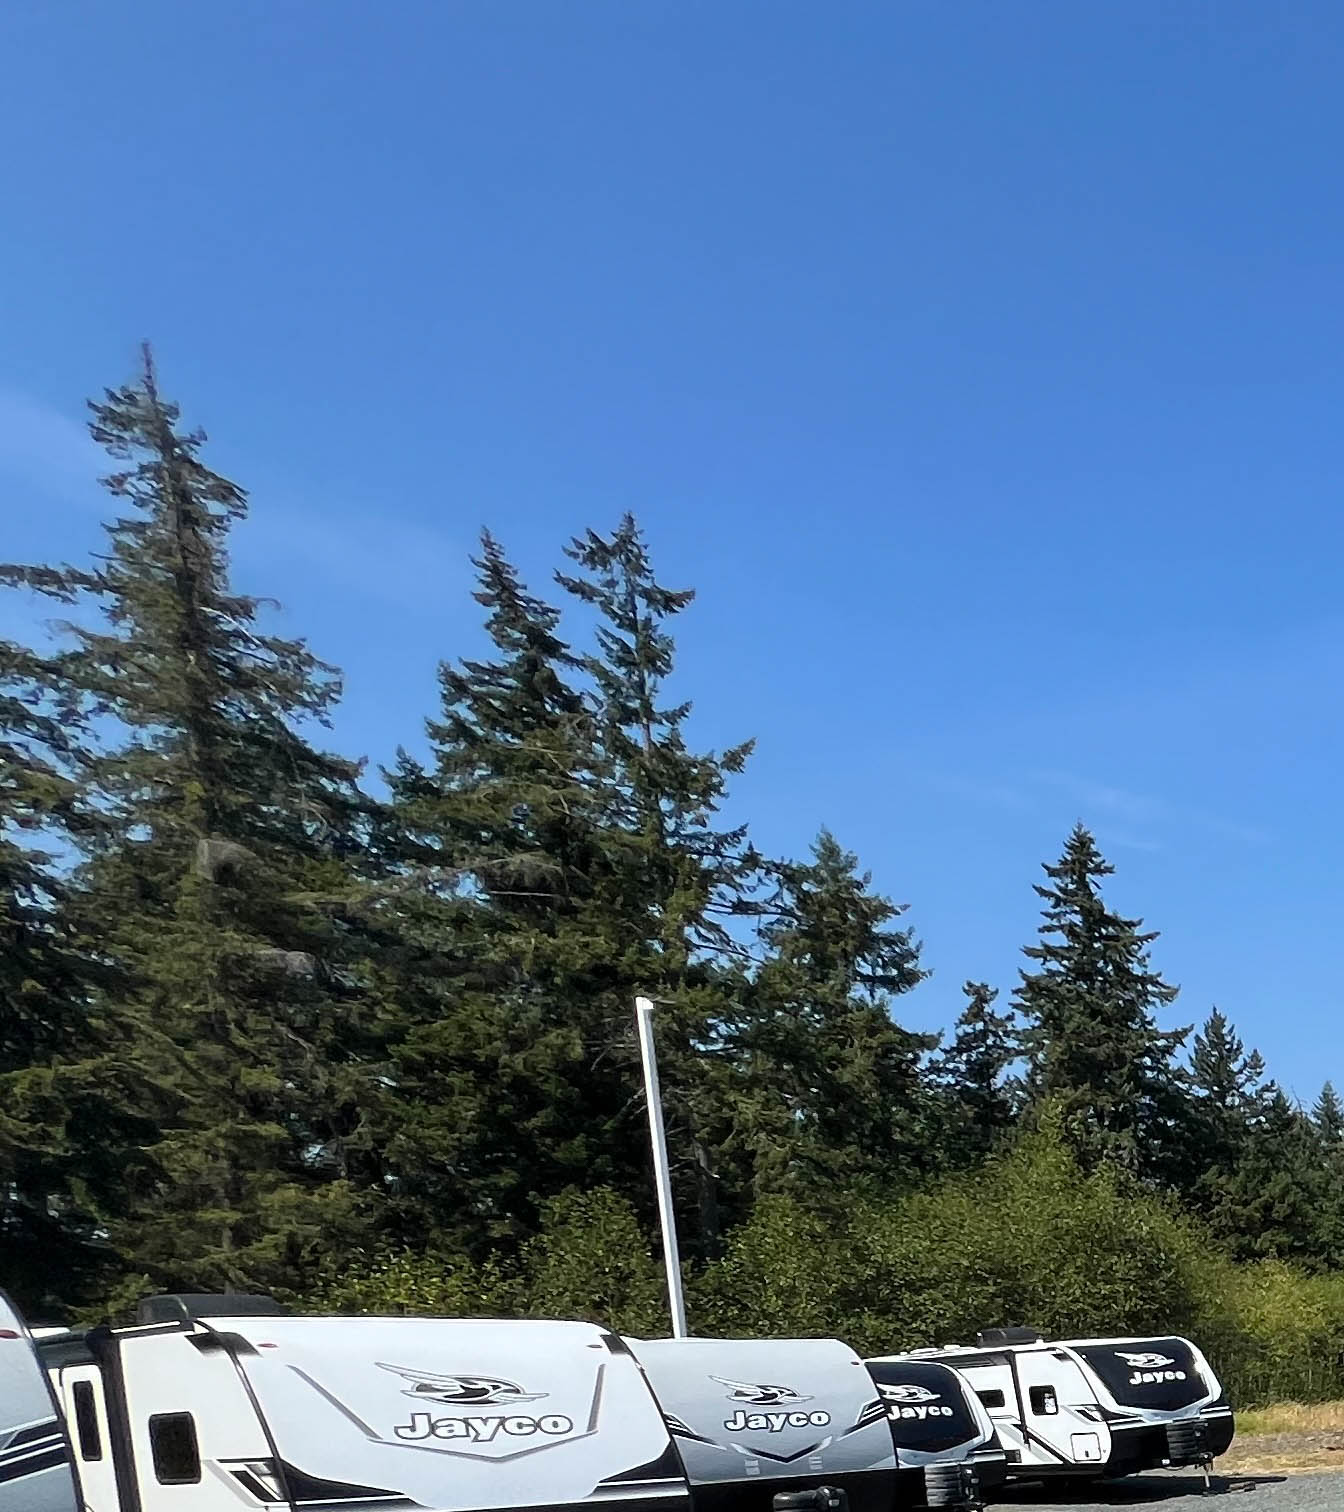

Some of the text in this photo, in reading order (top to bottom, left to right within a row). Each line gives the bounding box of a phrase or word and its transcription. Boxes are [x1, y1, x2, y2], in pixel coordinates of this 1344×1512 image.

[1129, 1370, 1186, 1385] Jayco
[724, 1410, 831, 1433] Jayco
[887, 1405, 953, 1421] Jayco
[393, 1412, 574, 1443] Jayco
